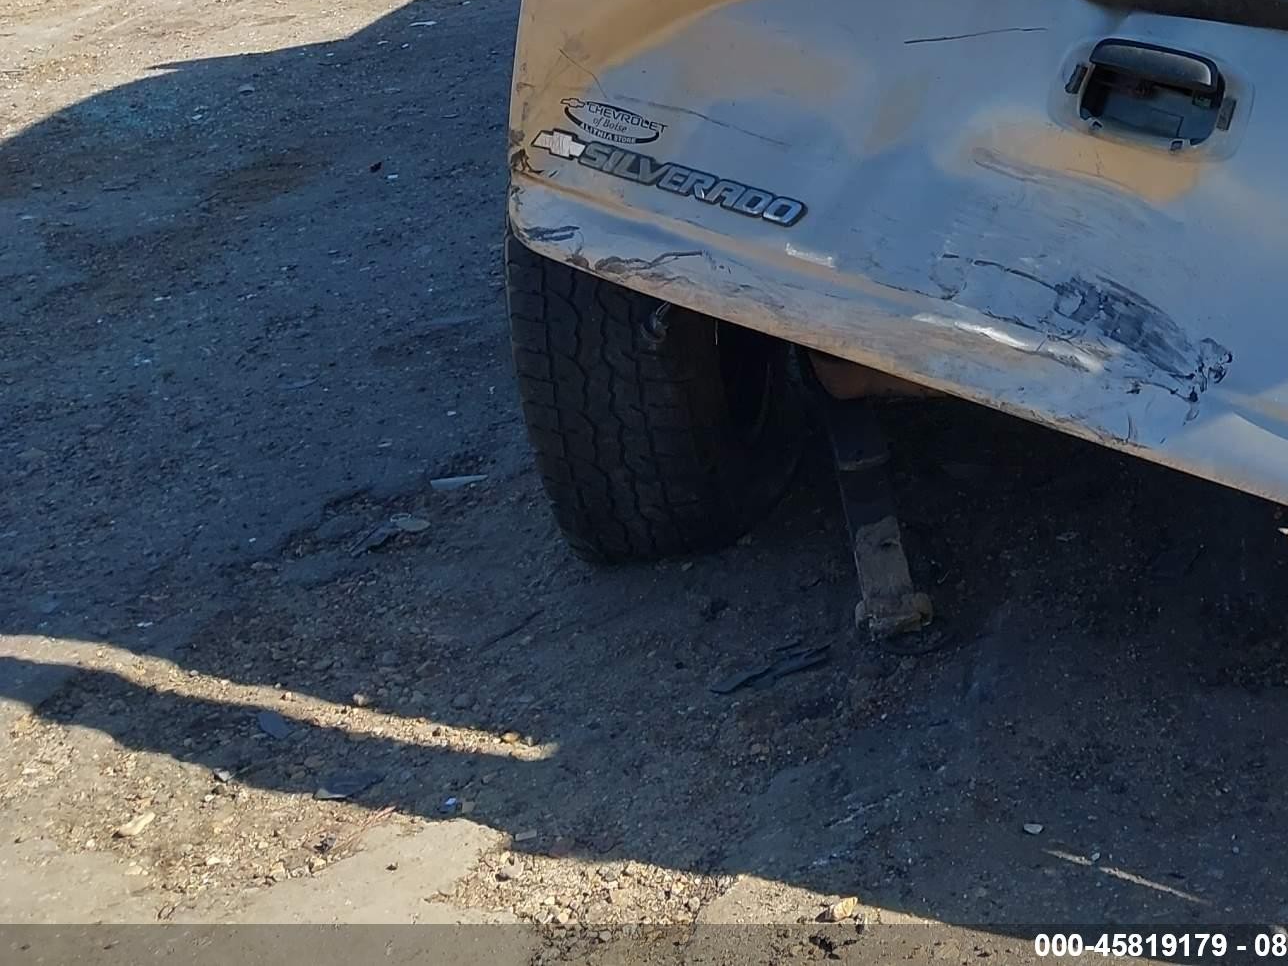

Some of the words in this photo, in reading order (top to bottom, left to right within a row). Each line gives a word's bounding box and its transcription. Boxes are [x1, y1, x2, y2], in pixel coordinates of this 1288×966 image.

[588, 103, 669, 133] CHEVROLET
[592, 116, 605, 127] of
[602, 118, 628, 133] Boise
[613, 134, 636, 144] STORE
[578, 141, 807, 227] SILVERADO
